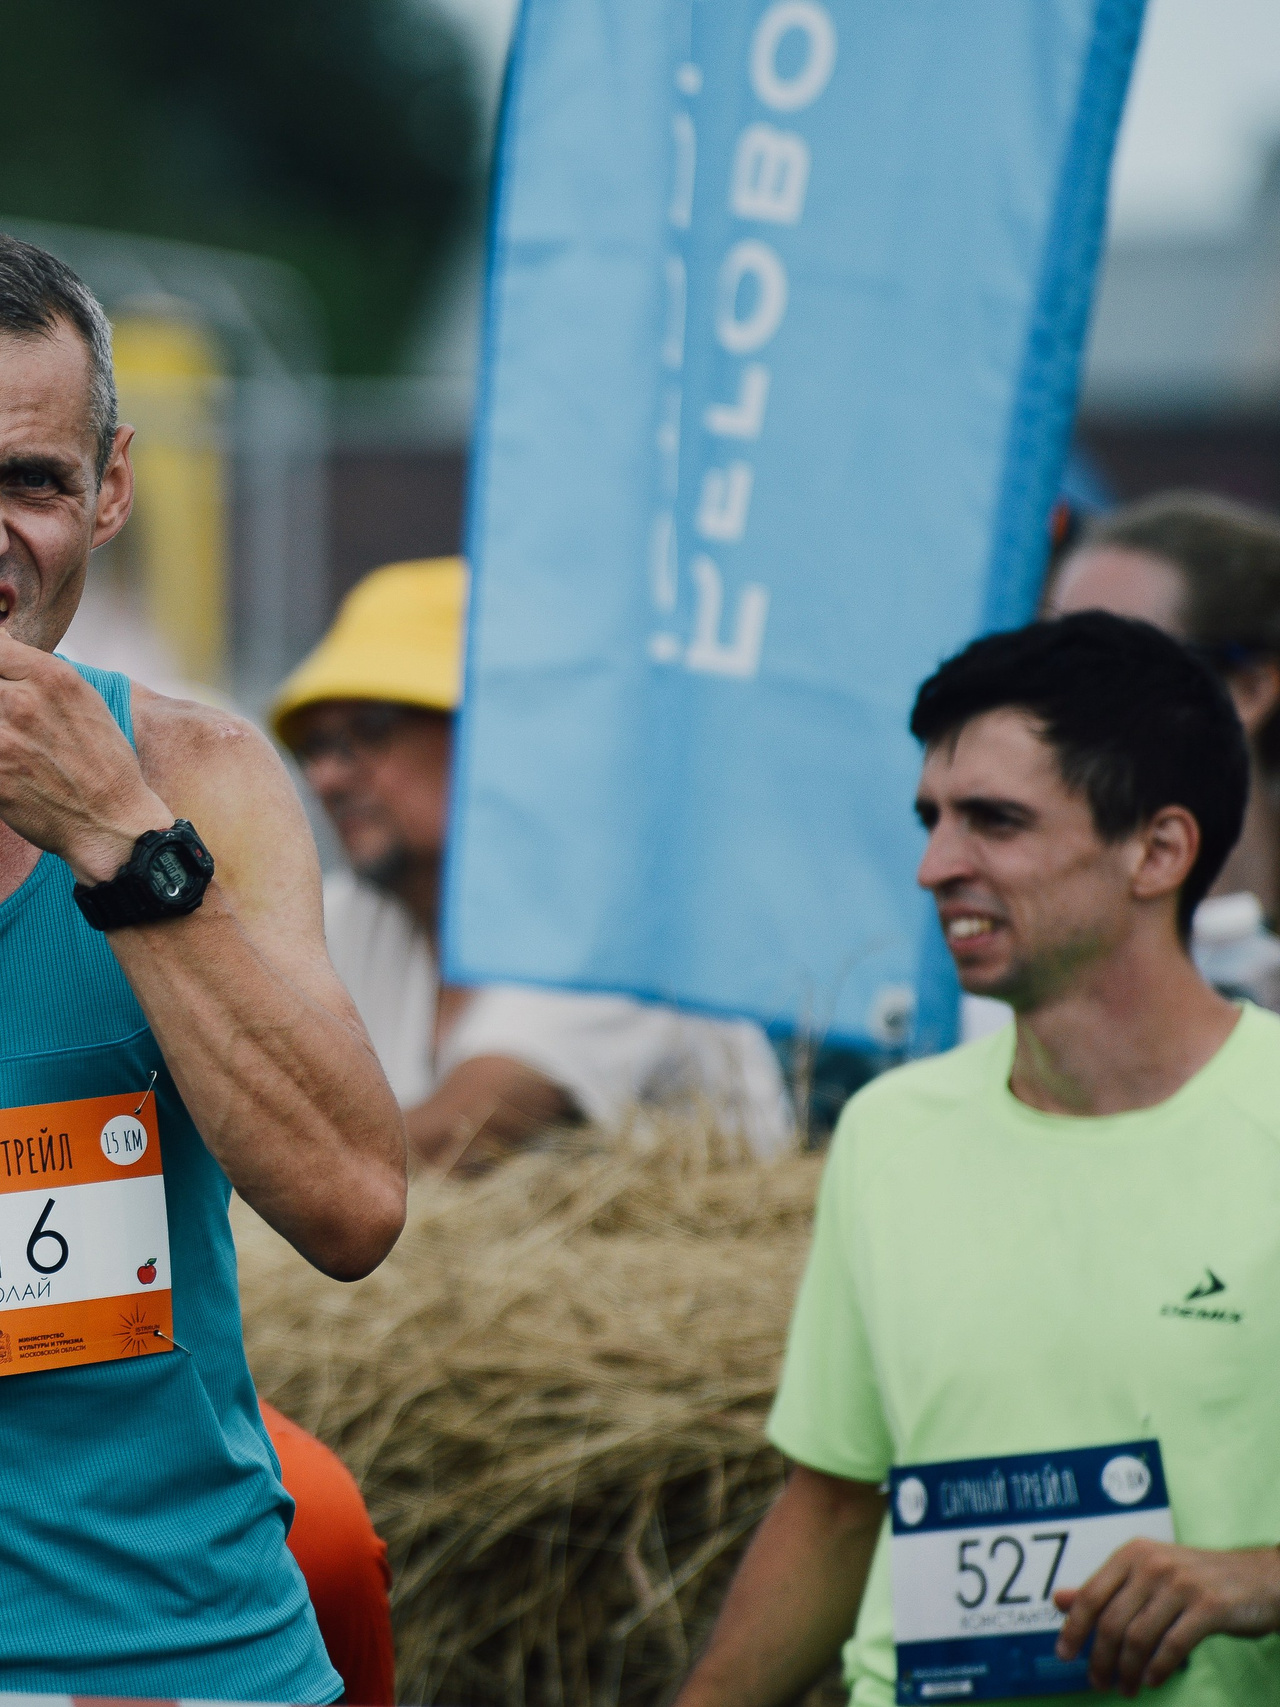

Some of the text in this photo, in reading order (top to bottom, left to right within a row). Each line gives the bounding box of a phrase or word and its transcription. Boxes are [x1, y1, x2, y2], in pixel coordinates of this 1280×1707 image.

[0, 1127, 74, 1177] ТРЕЙЛ
[102, 1132, 119, 1155] 15
[18, 1332, 65, 1343] МИНИСТЕРСТВО
[18, 1342, 50, 1351] КУЛЬТУРЫ
[56, 1337, 84, 1346] ТУРИЗМА
[19, 1344, 87, 1358] МОСКОВСКОЙ ОБЛАСТИ
[955, 1531, 1069, 1609] 527
